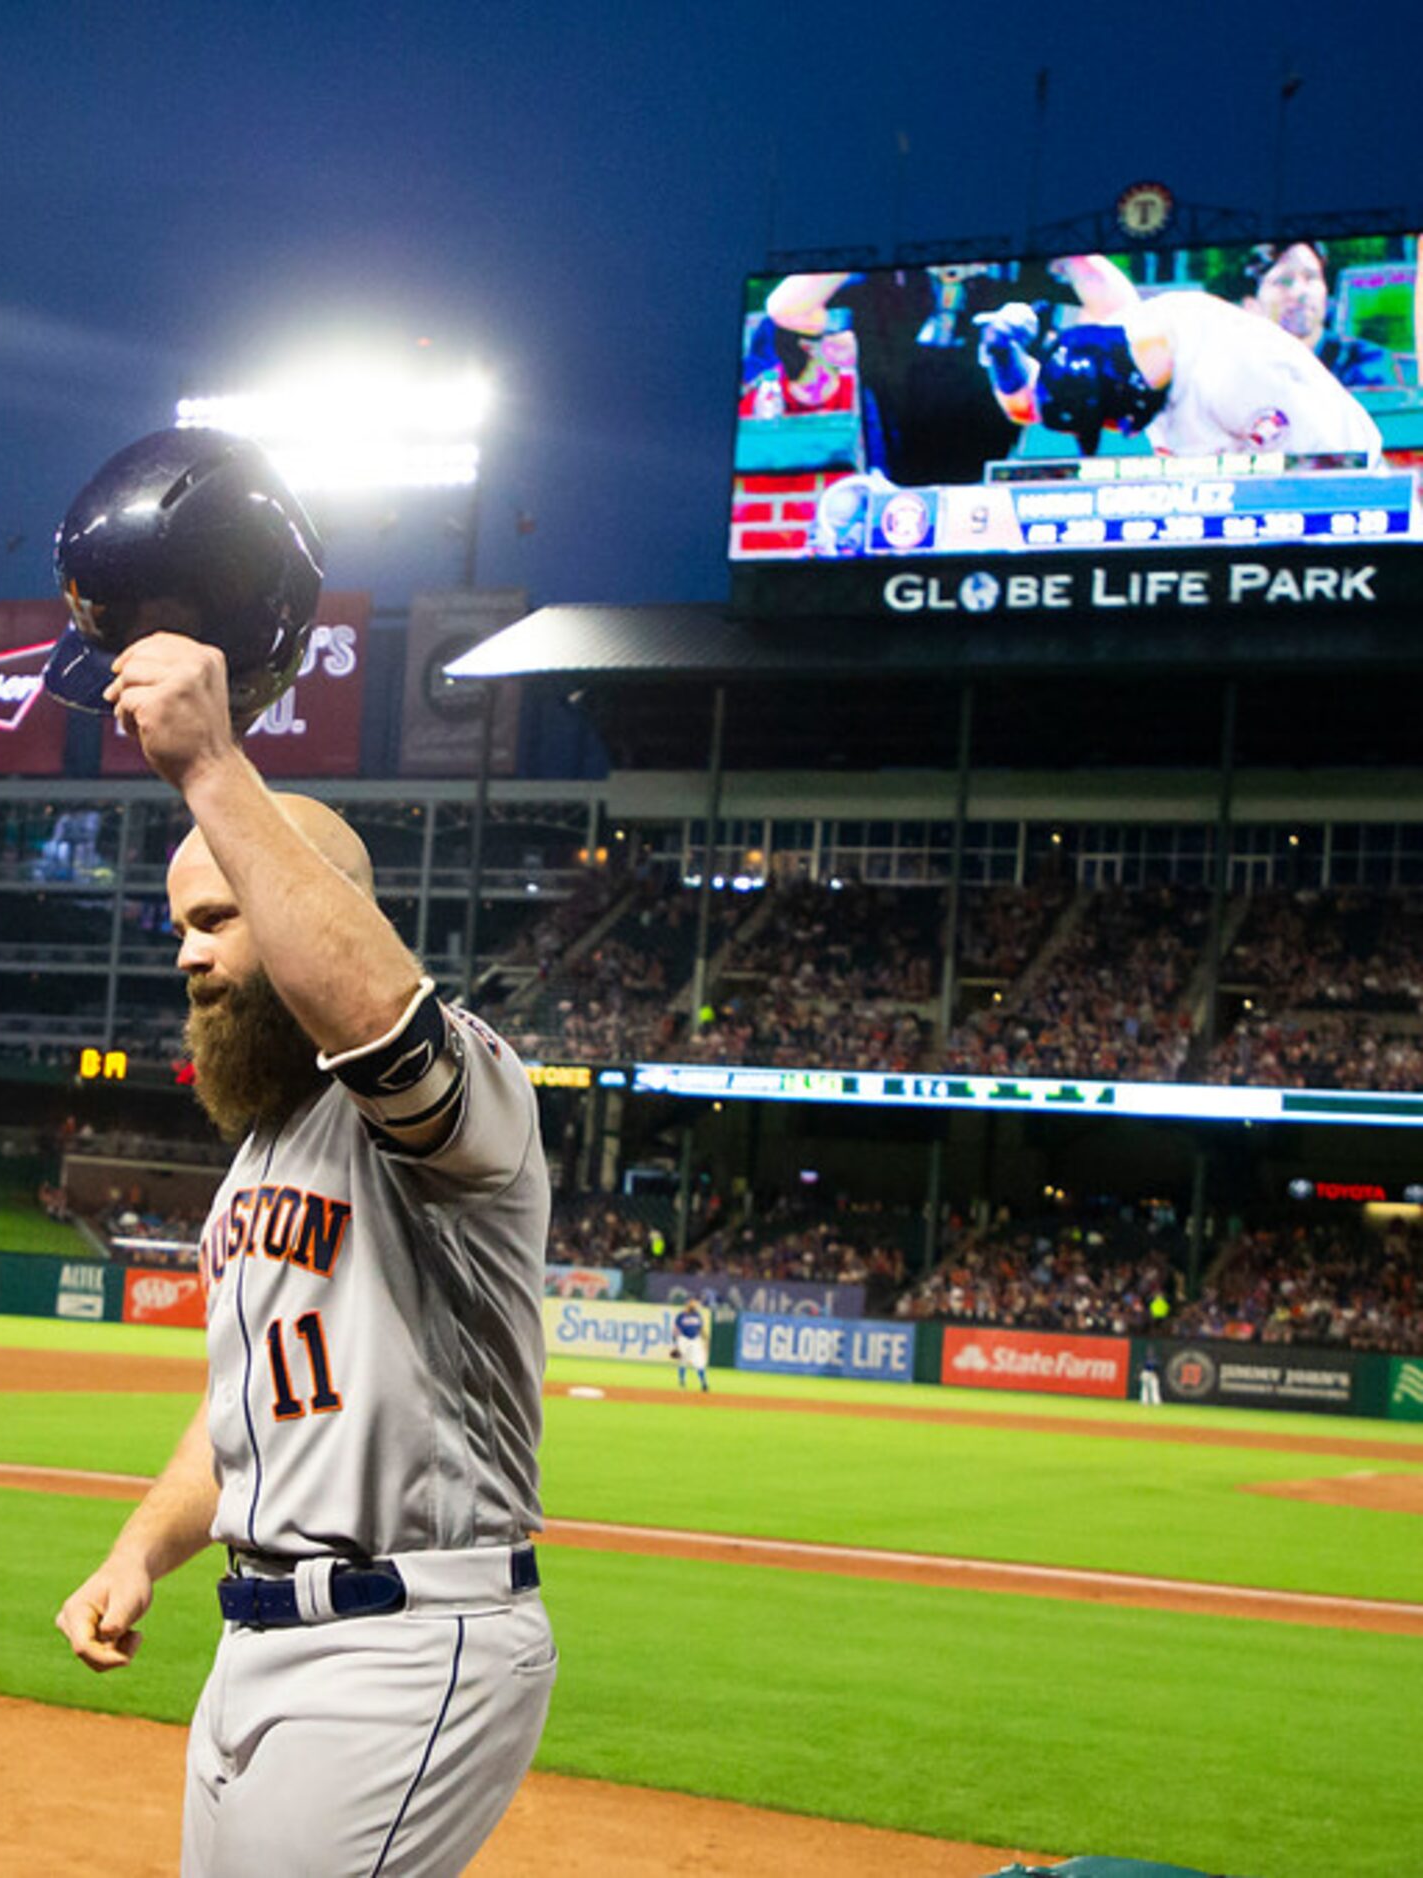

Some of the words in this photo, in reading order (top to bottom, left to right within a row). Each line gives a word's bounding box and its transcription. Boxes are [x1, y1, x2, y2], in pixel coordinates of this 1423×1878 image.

[970, 505, 989, 535] 9
[1316, 1181, 1387, 1200] TOYOTA
[556, 1304, 674, 1354] Snappl
[769, 1325, 844, 1366] GLOBE
[852, 1331, 909, 1371] LIFE
[267, 1311, 343, 1421] 11
